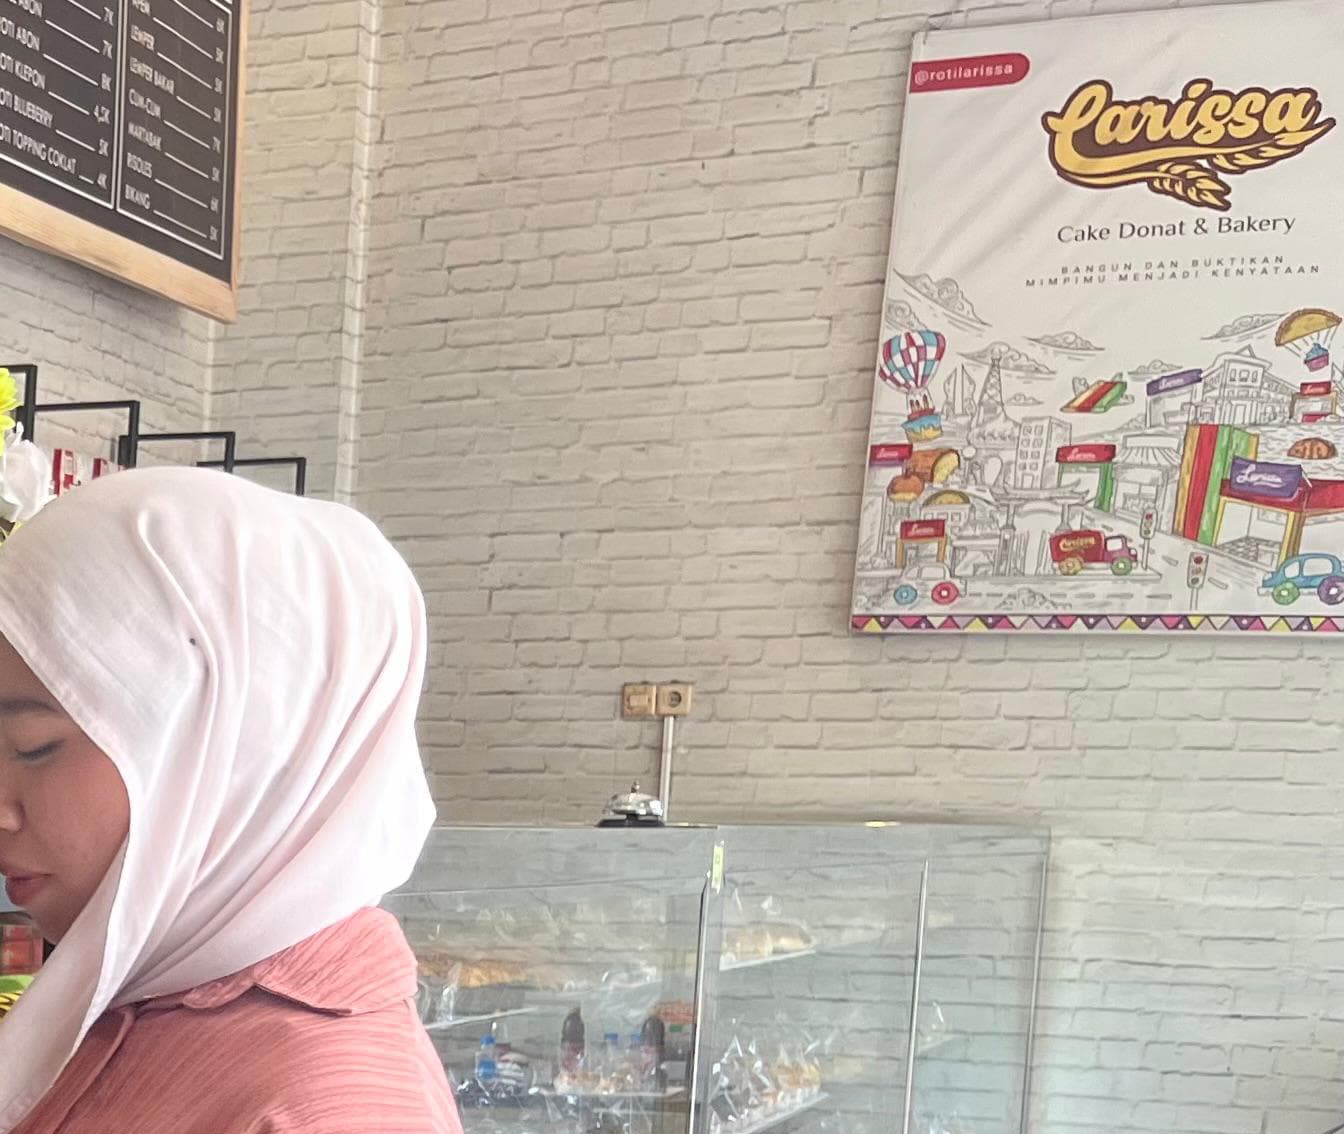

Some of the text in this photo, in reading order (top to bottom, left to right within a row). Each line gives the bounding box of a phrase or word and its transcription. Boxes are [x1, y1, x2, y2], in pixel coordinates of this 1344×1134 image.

[914, 64, 1013, 86] @rotilarissa
[1043, 79, 1320, 188] Larissa
[12, 129, 47, 161] TOPPING
[47, 146, 77, 174] COKLAT
[1056, 215, 1297, 243] Cake Donat & Bakery
[1025, 264, 1321, 288] MIMPIMU MENJADI KENYATAAN
[1061, 255, 1285, 275] BANGUN DAN BUKTIKAN
